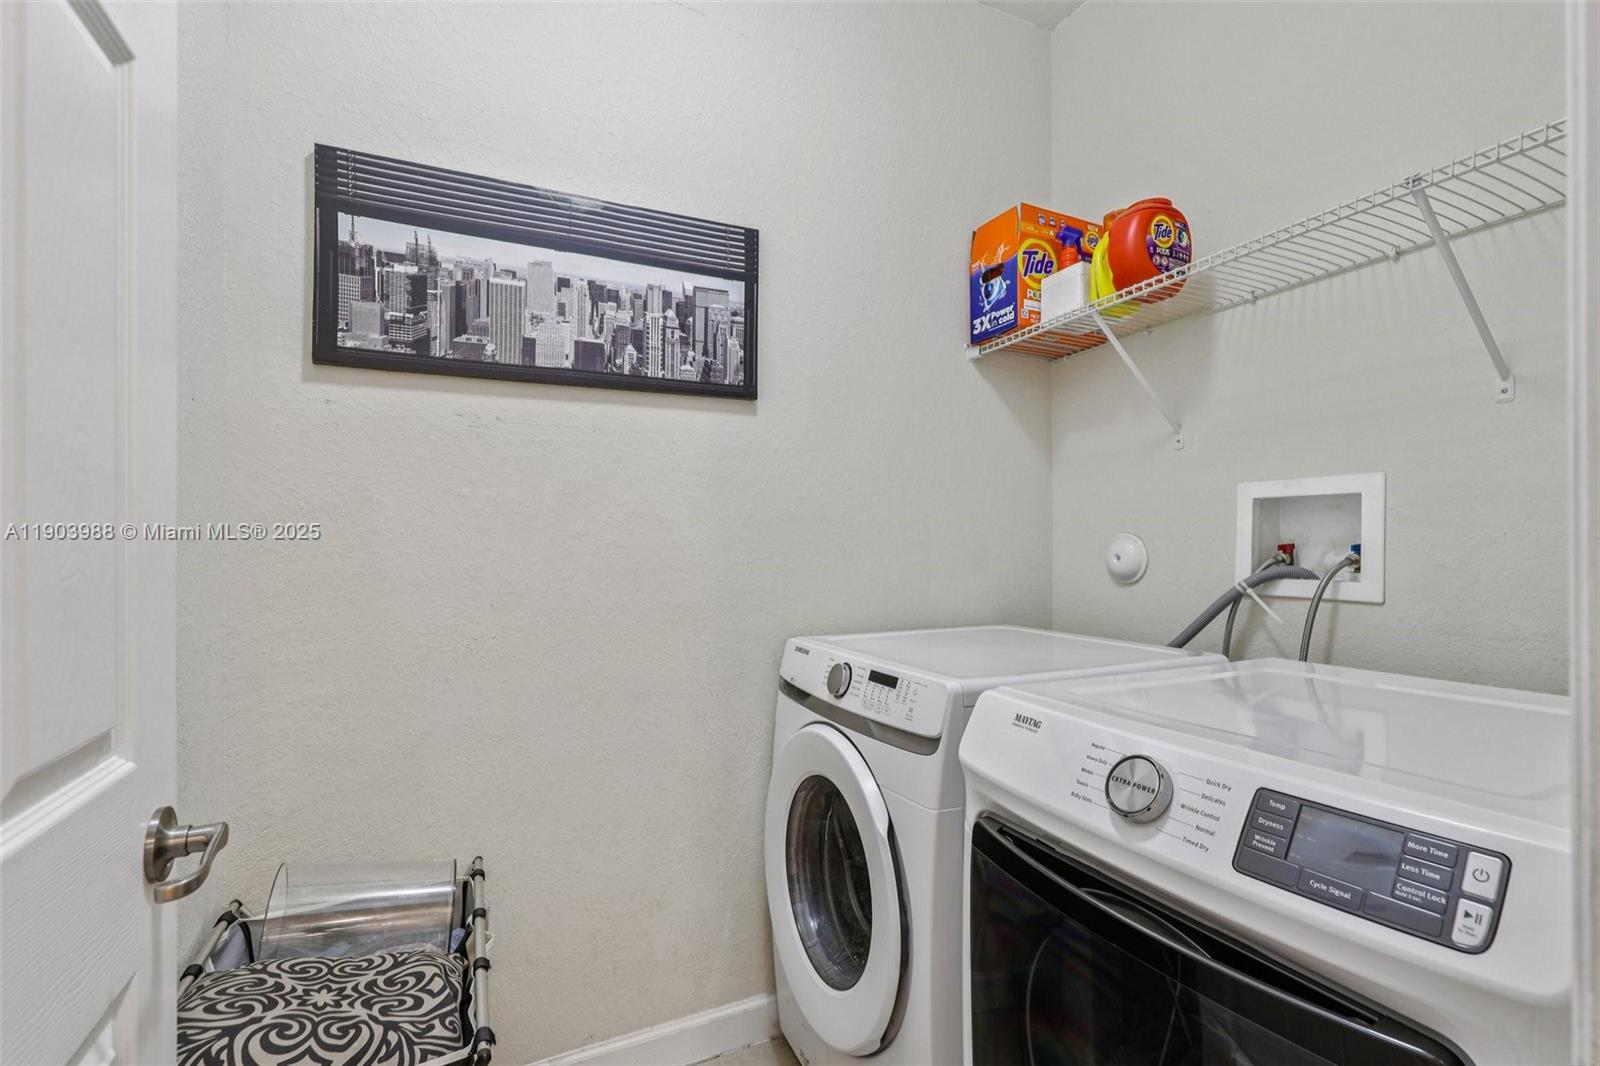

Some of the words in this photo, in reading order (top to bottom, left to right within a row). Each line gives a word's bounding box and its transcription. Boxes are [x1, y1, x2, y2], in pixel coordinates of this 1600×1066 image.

[1154, 223, 1172, 240] Tide
[1022, 250, 1054, 277] Tide
[973, 315, 992, 335] 3X
[991, 304, 1015, 320] Power
[998, 311, 1015, 325] cold
[1013, 713, 1043, 729] MAYTAG
[1111, 775, 1131, 787] EXTRA
[1132, 782, 1156, 795] POWER
[1206, 778, 1221, 788] Quick
[1222, 783, 1233, 792] Dry
[1201, 793, 1226, 806] Delicates
[1268, 800, 1286, 811] Temp
[1180, 803, 1200, 815] Wrinkle
[1200, 809, 1221, 822] Control
[1195, 824, 1216, 837] Normal
[1258, 817, 1284, 831] Dryness
[1182, 836, 1199, 848] Timed
[1199, 842, 1210, 852] Dry
[1252, 840, 1275, 853] Prevent
[1254, 834, 1276, 846] Wrinkle
[1407, 841, 1428, 852] More
[1429, 847, 1449, 858] Time
[1401, 863, 1420, 874] Less
[1421, 868, 1441, 880] Time
[1309, 880, 1328, 892] Cycle
[1329, 886, 1351, 899] Signal
[1396, 883, 1426, 897] Control
[1428, 893, 1447, 904] Lock
